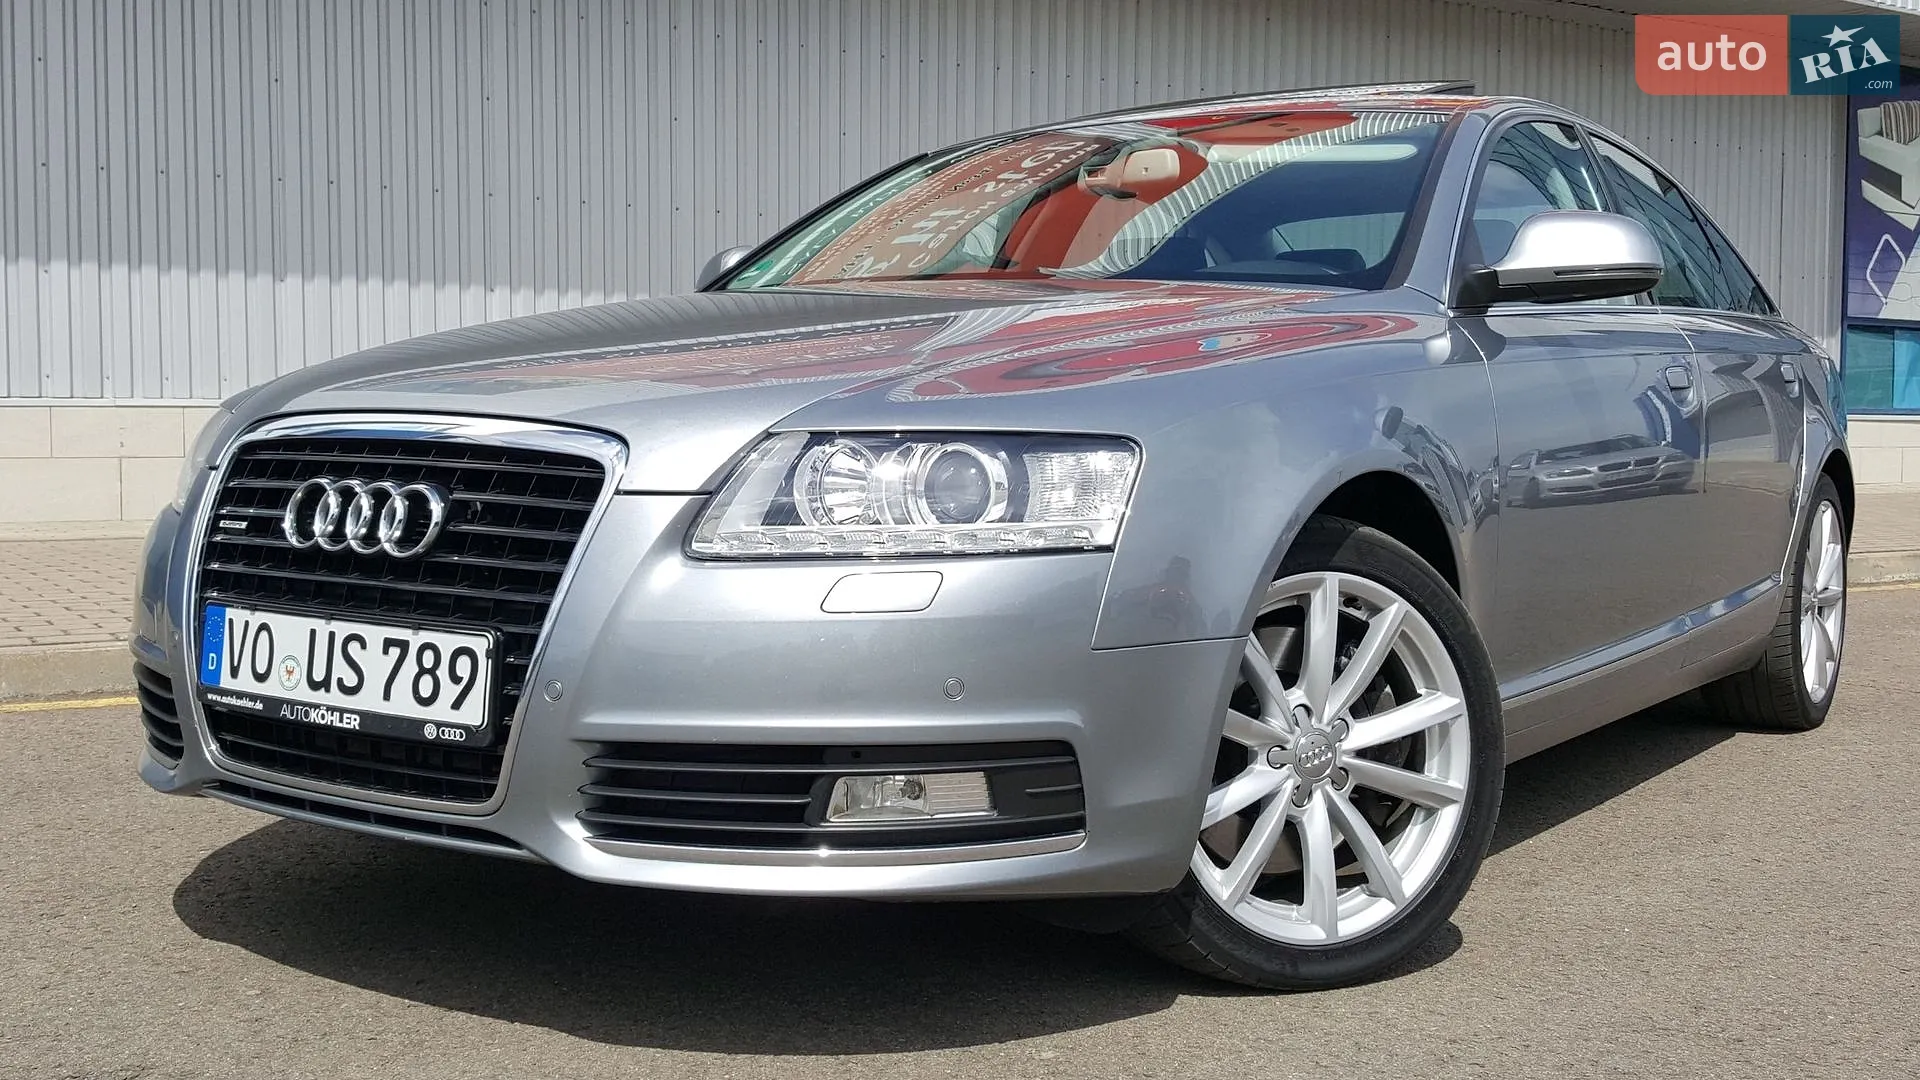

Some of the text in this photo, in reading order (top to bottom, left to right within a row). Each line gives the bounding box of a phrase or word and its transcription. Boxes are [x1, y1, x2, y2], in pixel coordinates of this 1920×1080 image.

[207, 652, 217, 671] D
[227, 617, 276, 684] VO
[305, 627, 368, 697] US
[381, 636, 480, 712] 789
